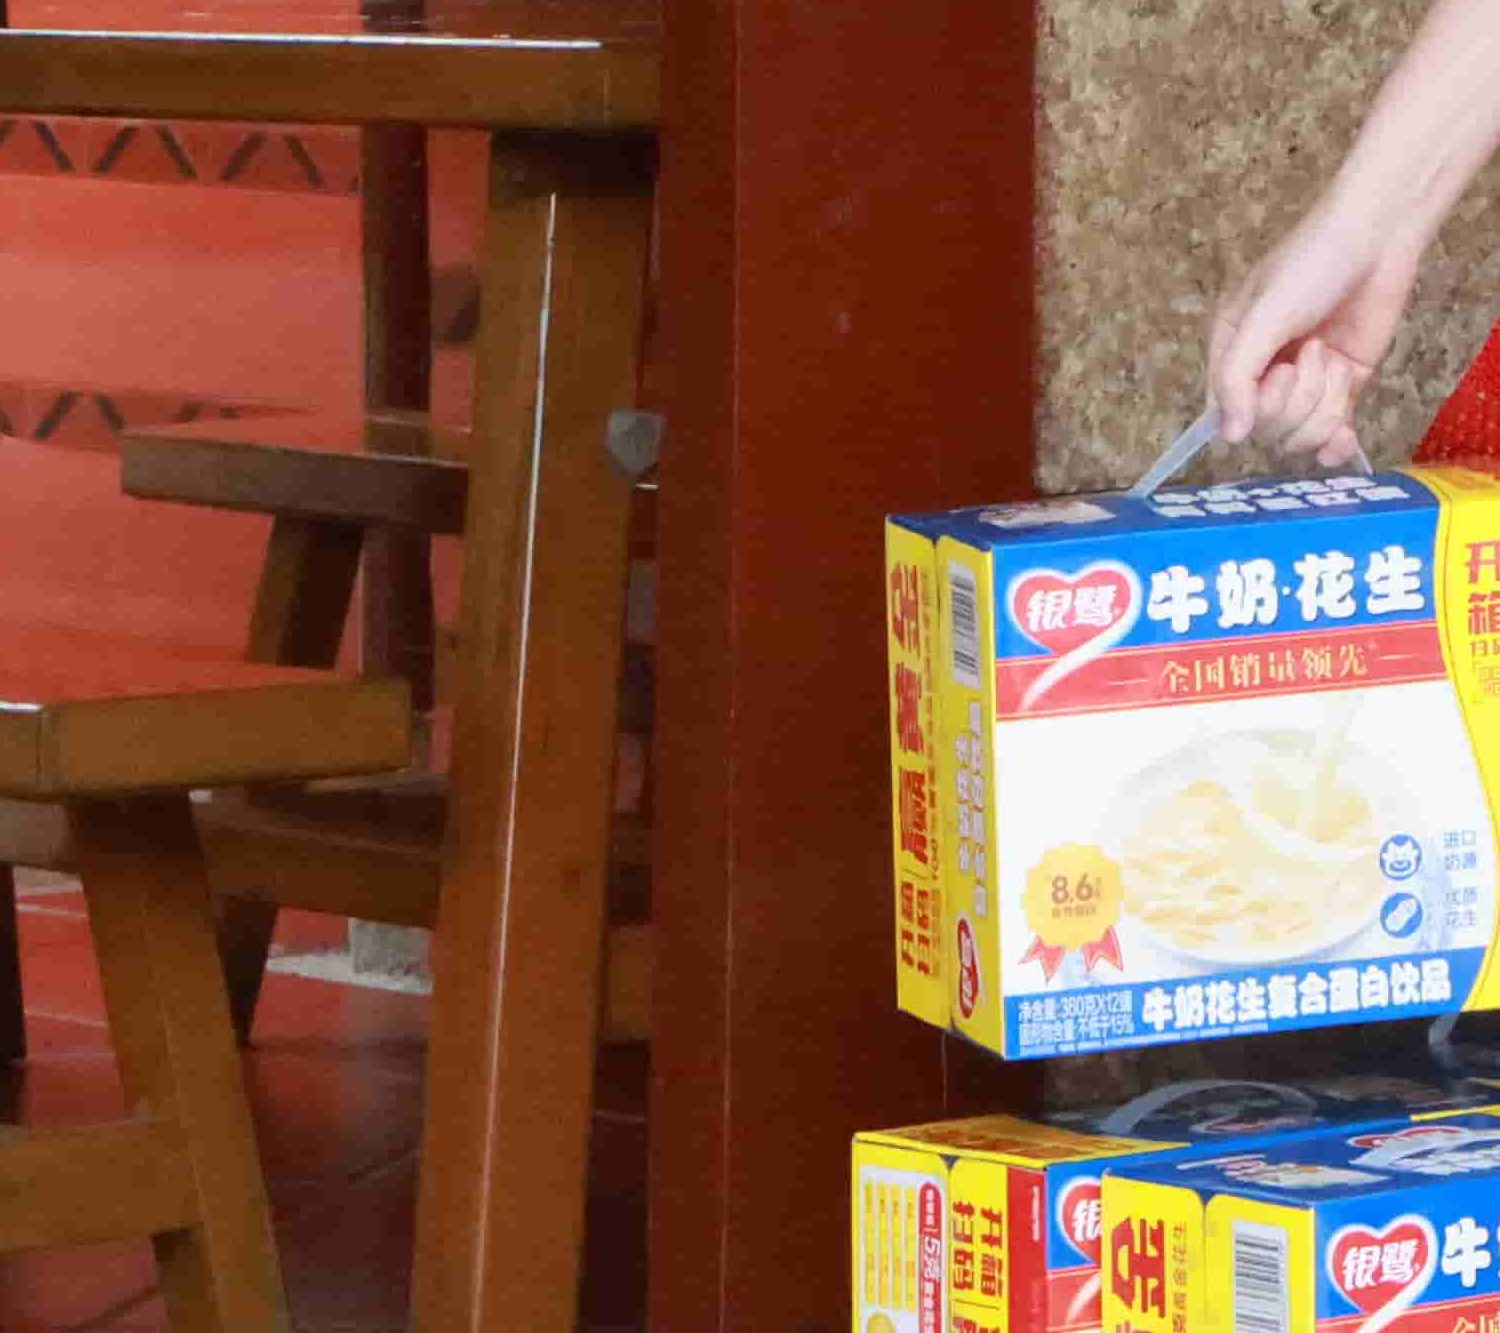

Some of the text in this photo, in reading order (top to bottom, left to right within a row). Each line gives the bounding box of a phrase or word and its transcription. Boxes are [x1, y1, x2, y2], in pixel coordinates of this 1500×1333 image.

[1027, 584, 1118, 631] 银鹭
[952, 1200, 975, 1291] 扫码
[980, 1205, 1002, 1297] 开箱
[1343, 1238, 1420, 1292] 银鹭
